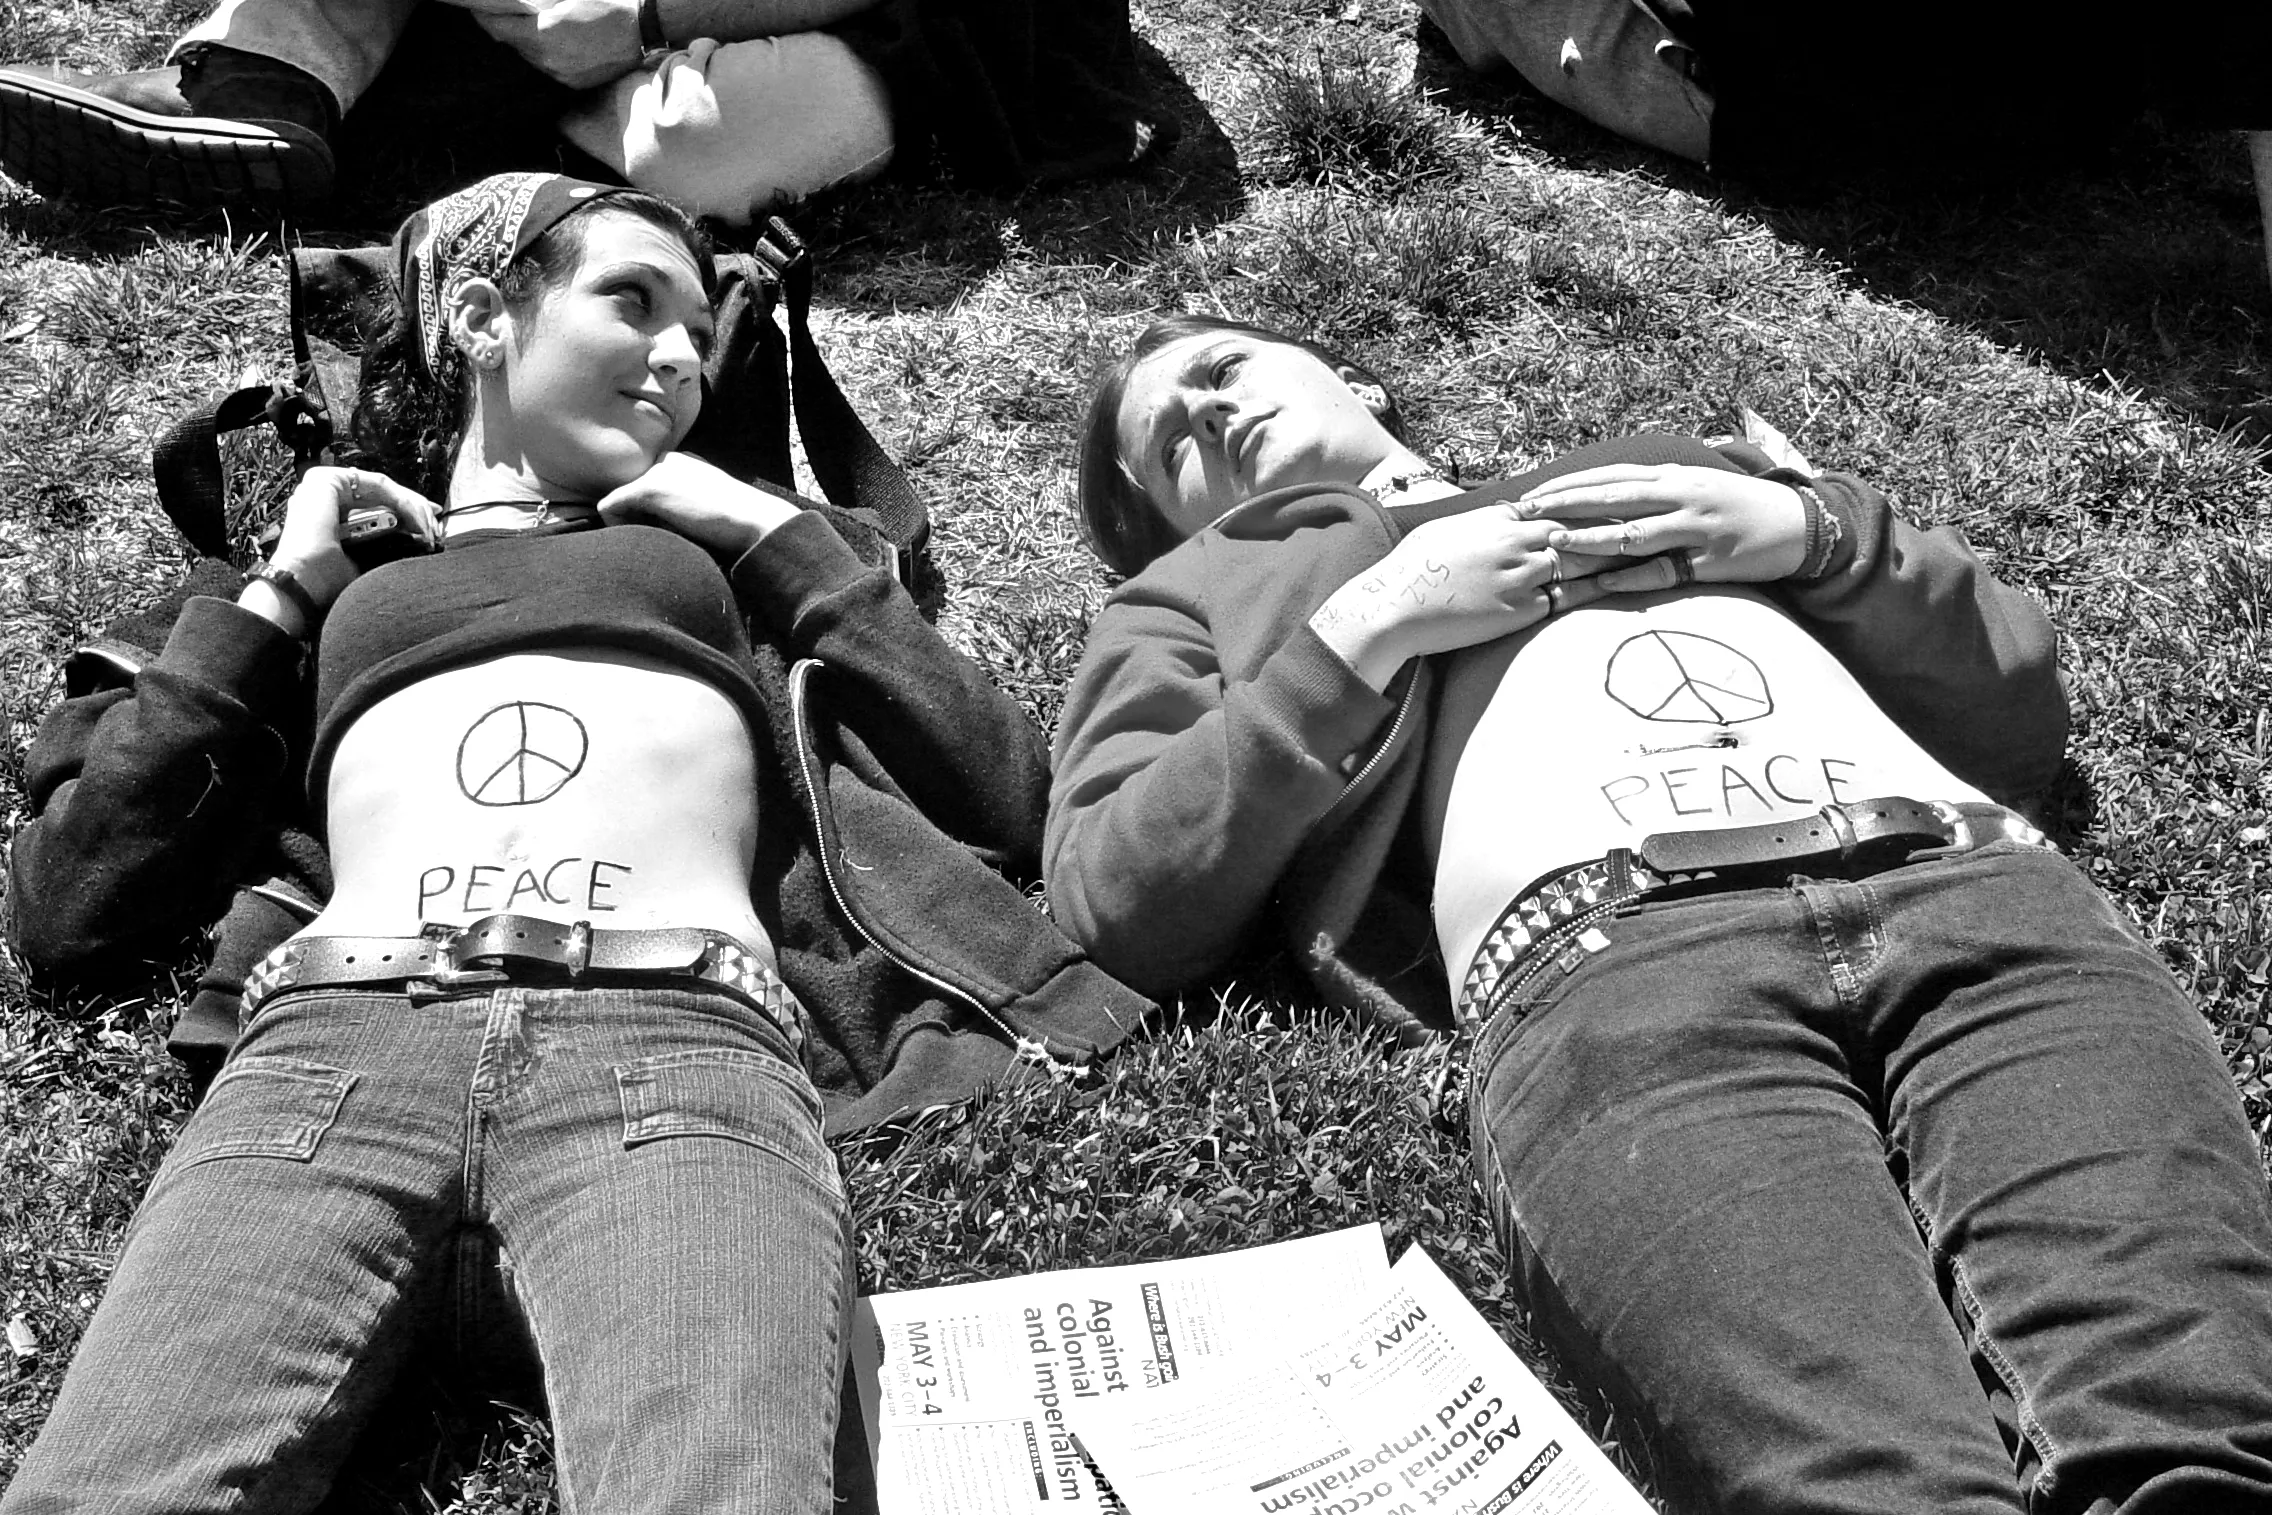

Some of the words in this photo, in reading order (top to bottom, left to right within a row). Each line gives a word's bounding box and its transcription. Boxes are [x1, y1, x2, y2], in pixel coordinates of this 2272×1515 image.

[1600, 754, 1857, 828] PEACE
[417, 857, 633, 921] PEACE
[890, 1323, 905, 1350] NEW
[1023, 1307, 1056, 1354] and
[1143, 1284, 1163, 1321] Where
[1154, 1332, 1172, 1360] Bush
[1374, 1305, 1428, 1358] MAY
[1385, 1296, 1416, 1325] NEW
[895, 1356, 911, 1387] YORK
[905, 1321, 934, 1369] MAY
[1056, 1302, 1100, 1398] colonial
[1088, 1299, 1128, 1392] Against
[901, 1391, 918, 1417] CITY
[1436, 1376, 1487, 1430] and
[1033, 1361, 1081, 1501] imperialism
[1399, 1397, 1503, 1489] colonial
[1260, 1424, 1437, 1514] imperialism
[1419, 1414, 1522, 1506] Against
[1511, 1480, 1524, 1494] is
[1521, 1444, 1560, 1484] Where
